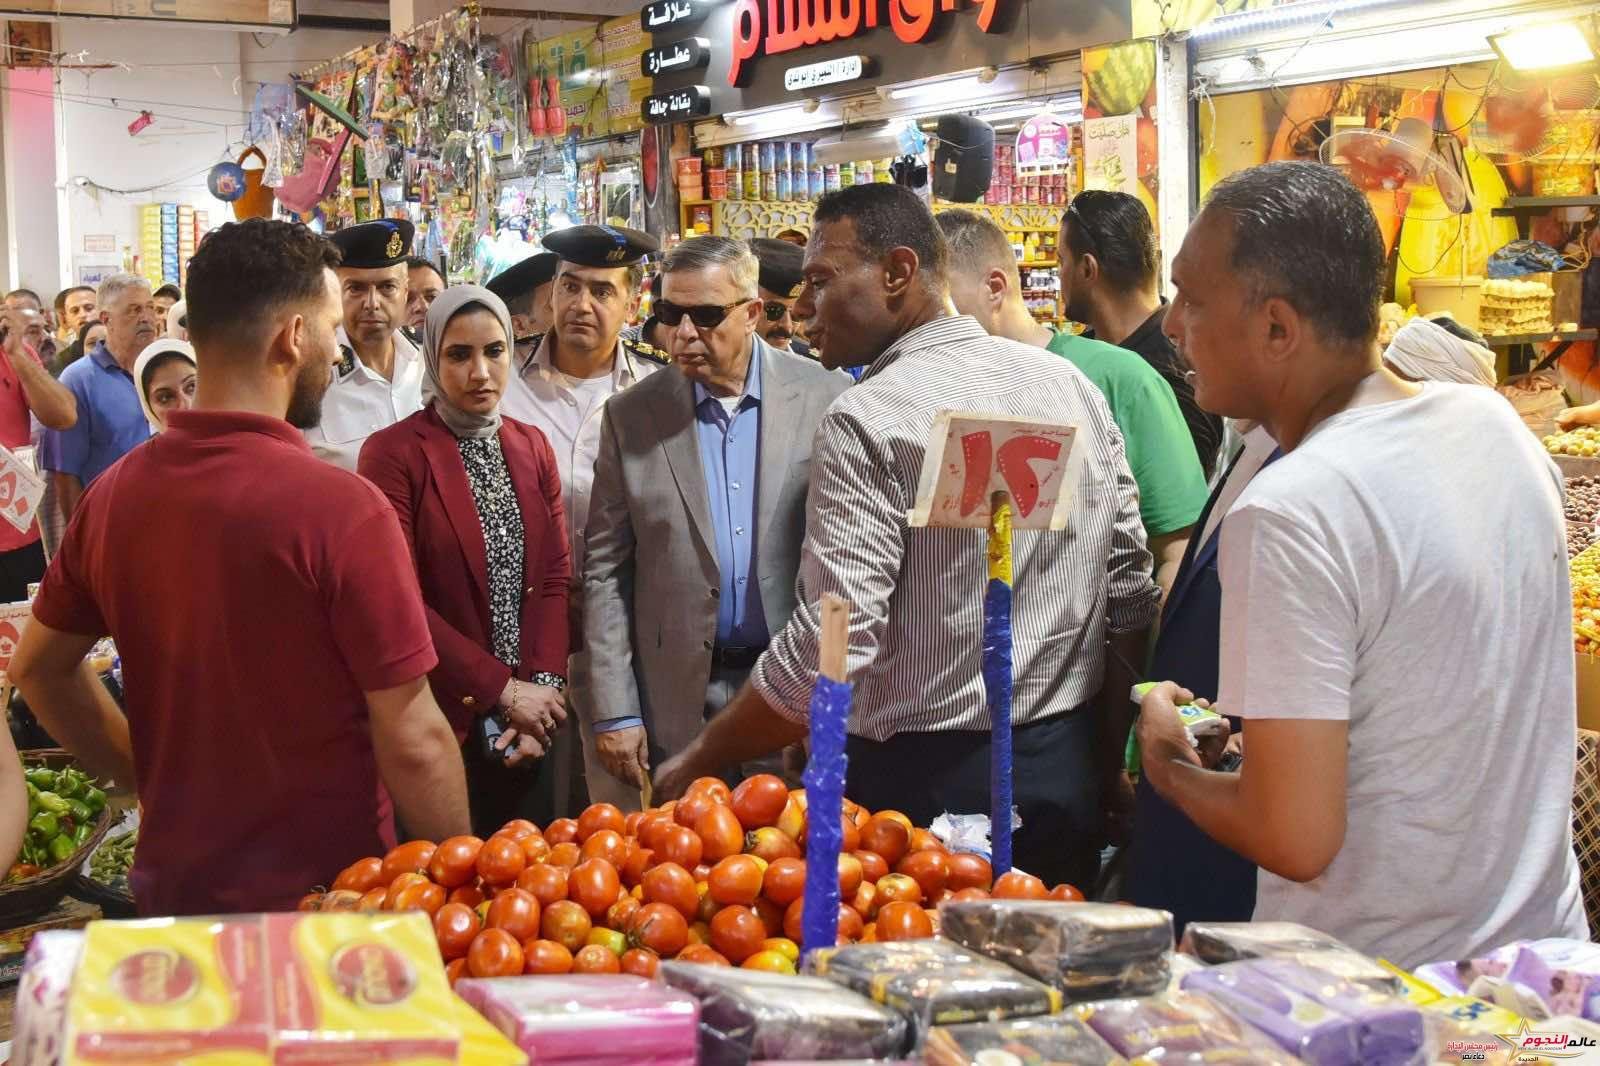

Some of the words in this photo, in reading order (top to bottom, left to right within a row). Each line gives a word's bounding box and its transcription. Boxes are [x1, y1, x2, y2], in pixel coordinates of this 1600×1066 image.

[649, 46, 690, 73] عطارة
[649, 99, 668, 116] جافة
[669, 93, 691, 114] بقالة
